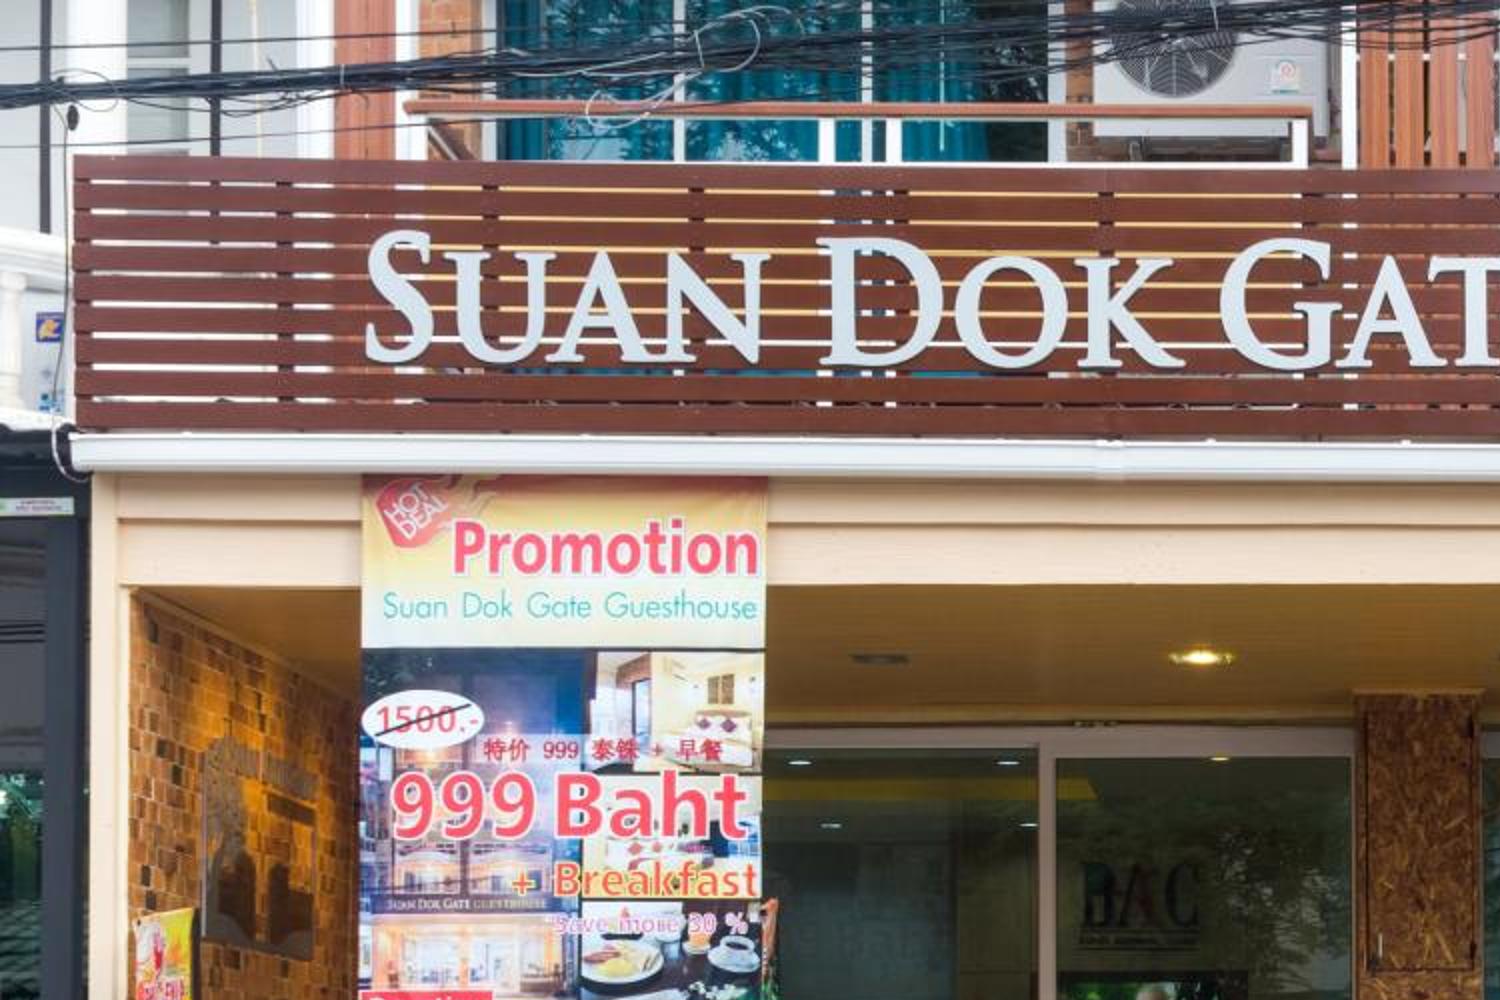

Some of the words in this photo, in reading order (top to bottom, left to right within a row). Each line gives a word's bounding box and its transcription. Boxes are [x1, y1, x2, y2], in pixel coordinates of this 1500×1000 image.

[364, 229, 773, 366] SUAN
[815, 236, 1186, 371] DOK
[383, 484, 430, 521] HOT
[399, 495, 449, 540] DEAL
[454, 519, 758, 575] Promotion
[383, 590, 448, 619] Suan
[463, 589, 513, 618] Dok
[526, 591, 592, 619] Gate
[604, 588, 758, 619] Guesthouse
[484, 739, 529, 762] 特价
[543, 740, 579, 760] 999
[677, 738, 723, 762] 早餐
[391, 770, 536, 840] 999
[555, 769, 748, 839] Baht
[555, 861, 759, 898] Breakfast
